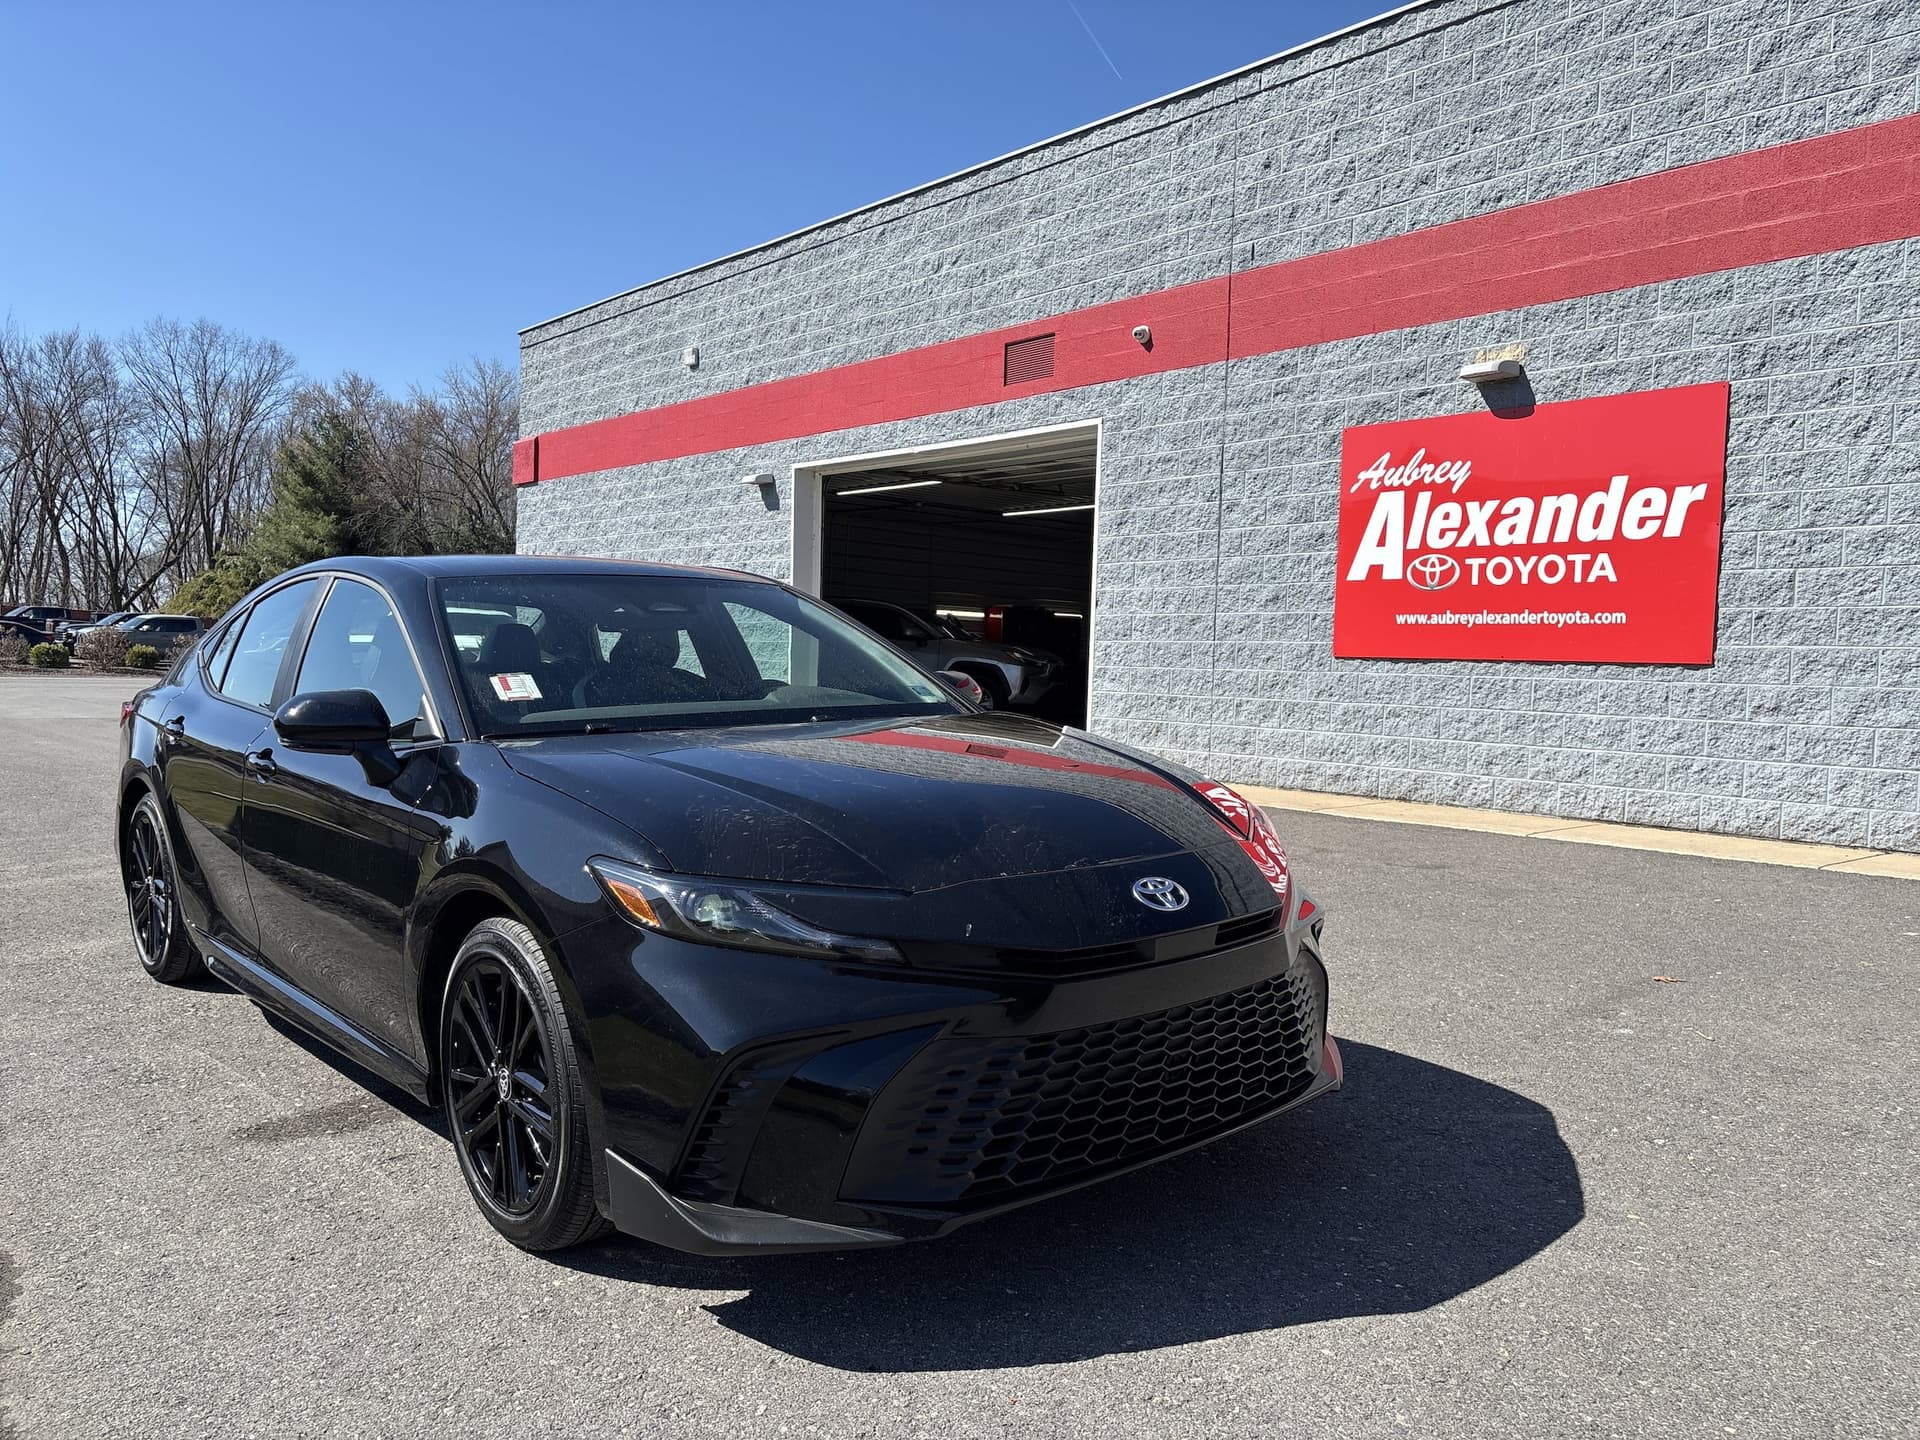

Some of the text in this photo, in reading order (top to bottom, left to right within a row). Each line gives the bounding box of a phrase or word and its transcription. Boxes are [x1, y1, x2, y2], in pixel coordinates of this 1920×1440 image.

[1350, 447, 1472, 494] Aubrey
[1346, 475, 1708, 581] Alexander
[1465, 552, 1617, 586] TOYOTA
[1395, 609, 1627, 629] www.aubreyalexandertoyota.com
